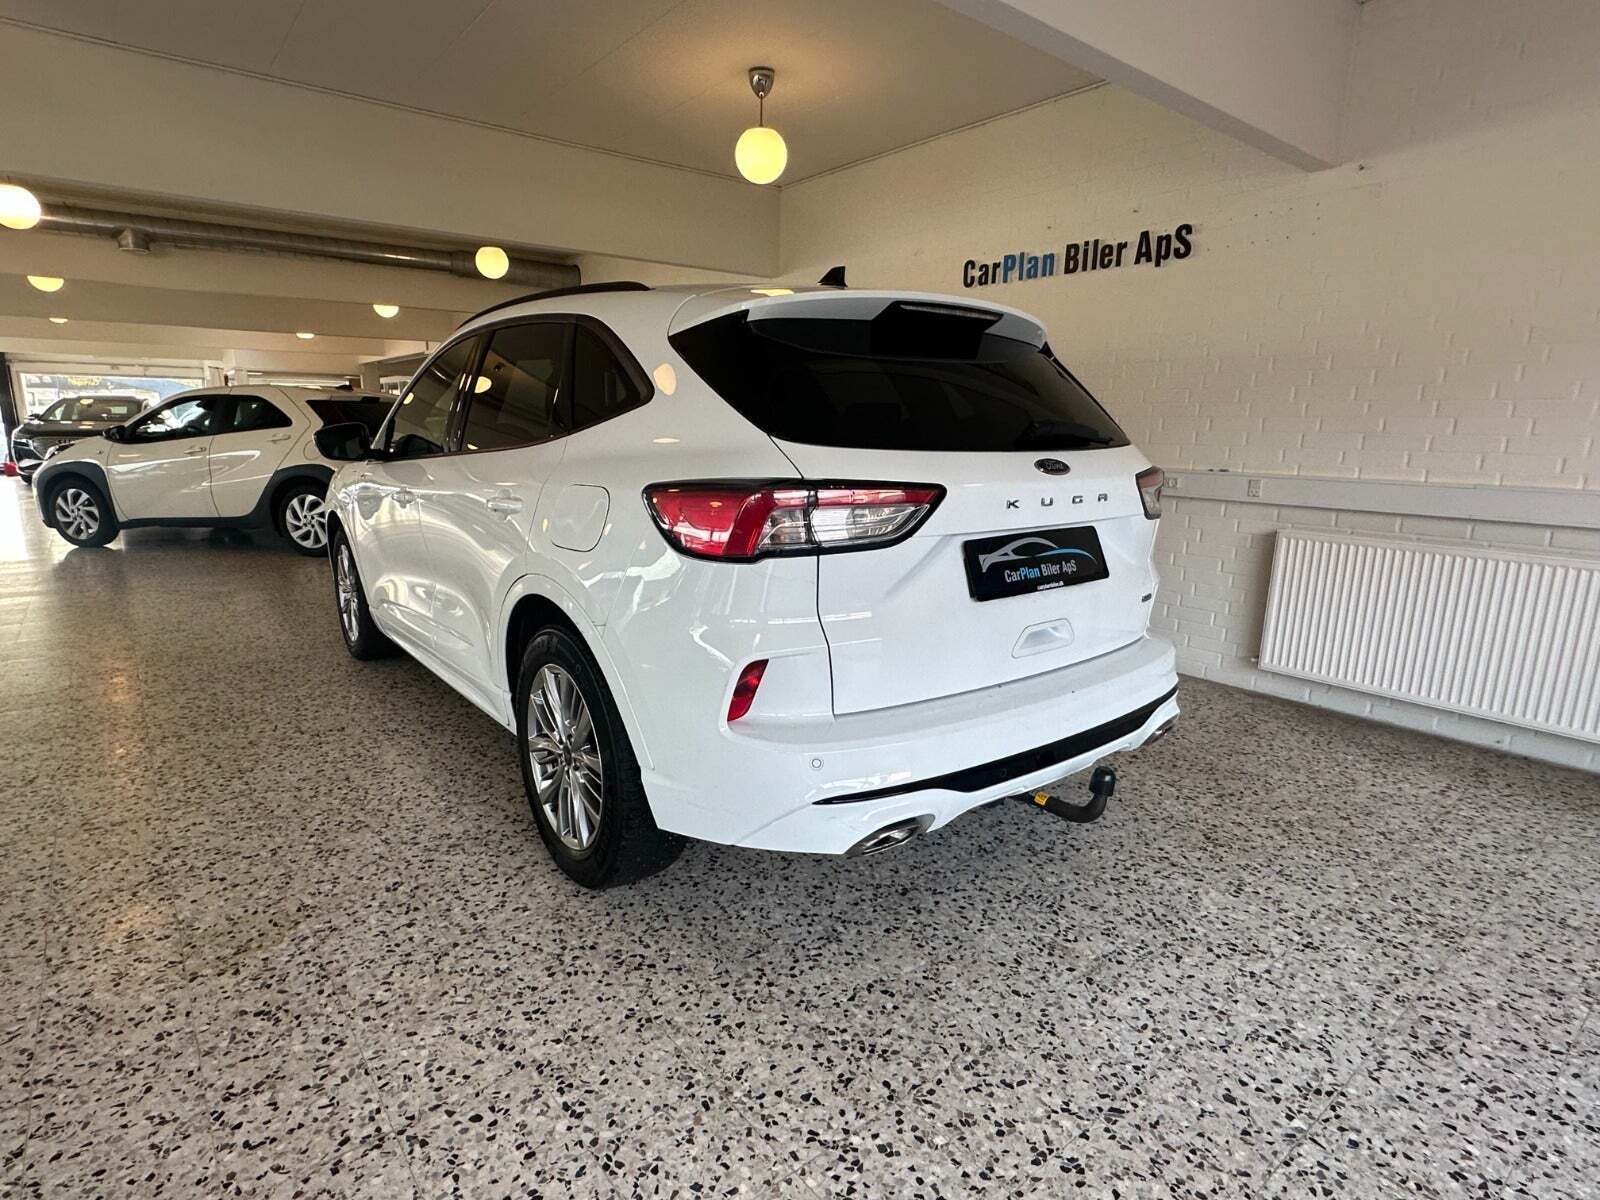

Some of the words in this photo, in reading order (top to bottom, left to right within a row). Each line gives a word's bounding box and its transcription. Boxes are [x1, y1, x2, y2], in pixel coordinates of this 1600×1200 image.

[963, 252, 1055, 289] CarPlan
[1064, 239, 1128, 275] Biler
[1134, 223, 1193, 267] ApS
[1007, 493, 1108, 509] KUGA
[1004, 567, 1040, 583] CarPlan
[1041, 563, 1060, 576] Biler
[1062, 560, 1077, 574] ApS
